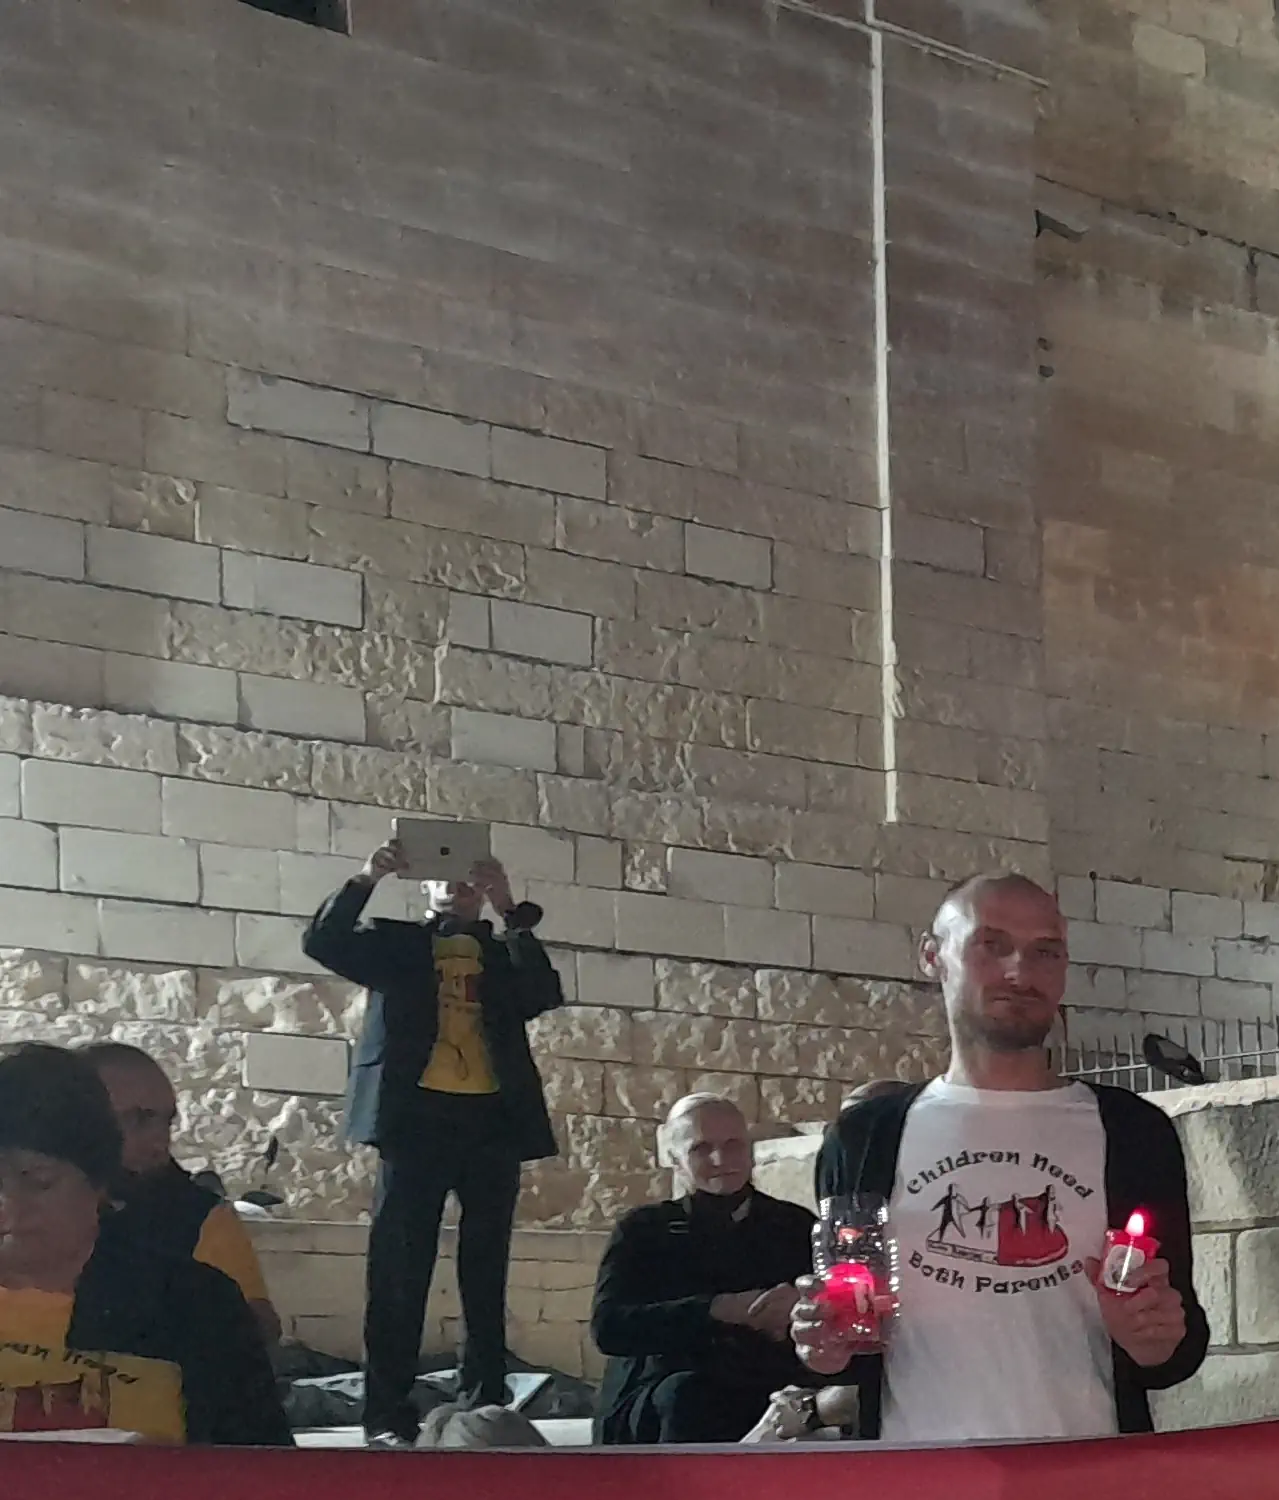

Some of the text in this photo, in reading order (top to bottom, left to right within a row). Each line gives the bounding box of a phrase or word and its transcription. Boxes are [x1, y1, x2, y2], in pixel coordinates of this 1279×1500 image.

[906, 1149, 1095, 1200] Children Need
[908, 1249, 966, 1290] Both
[975, 1259, 1085, 1295] Parents
